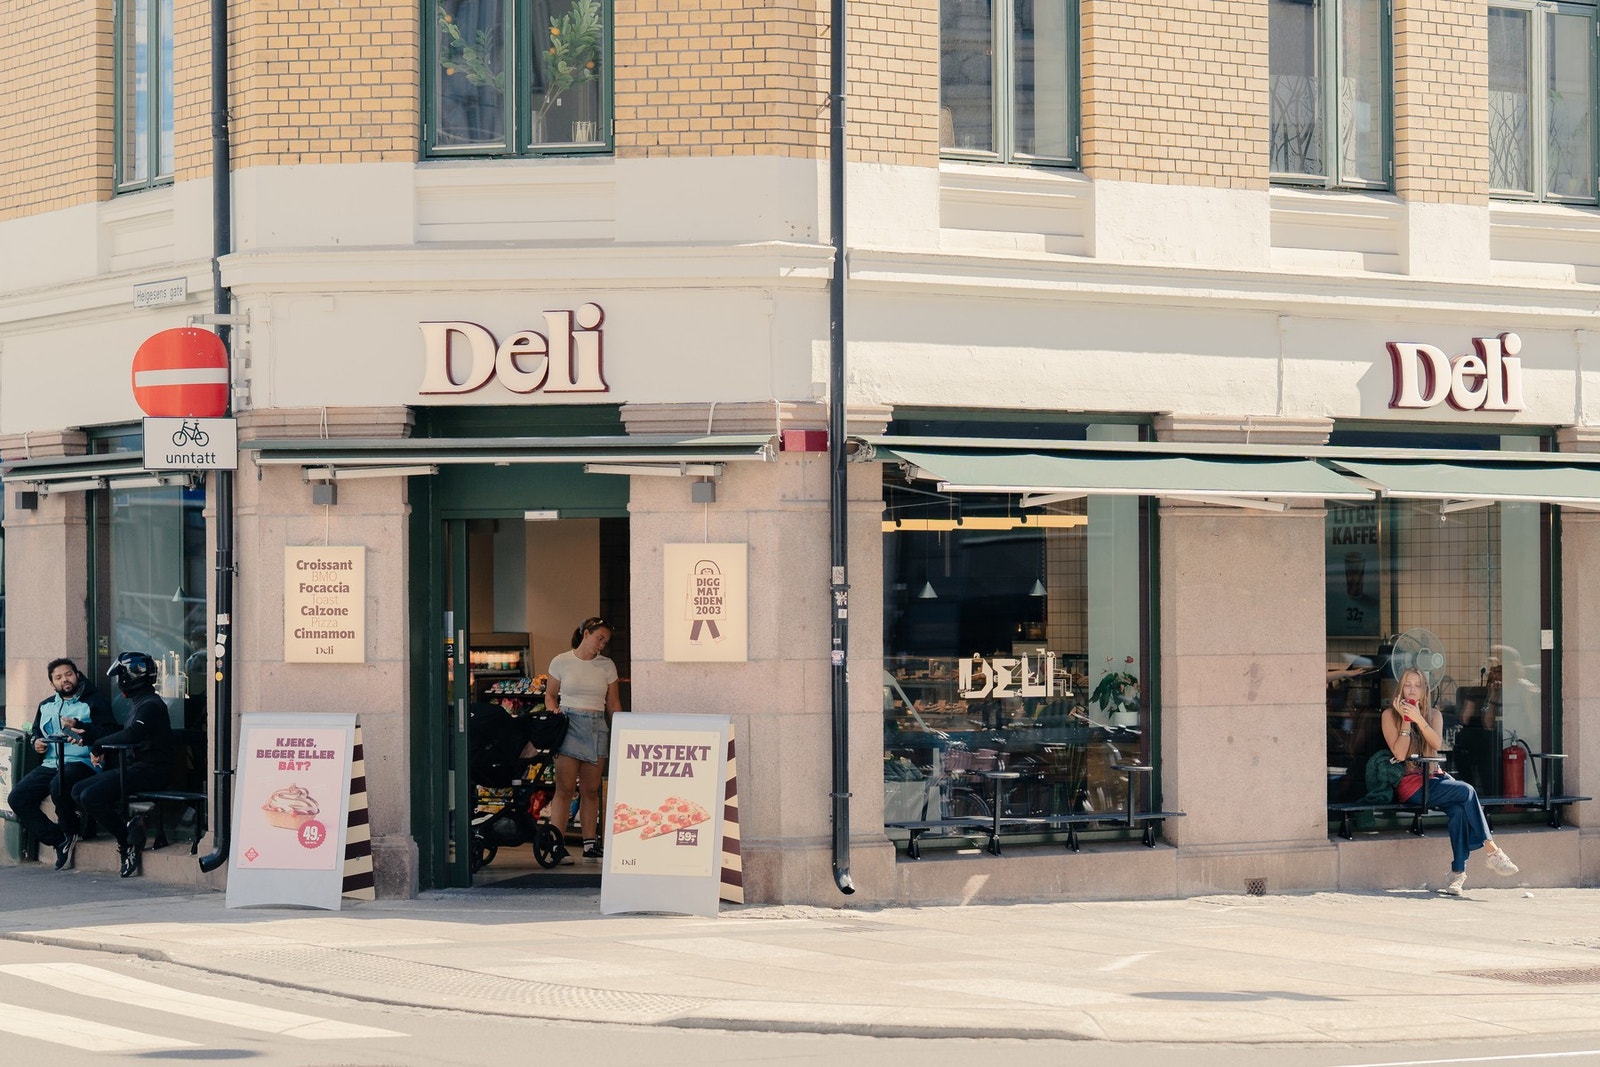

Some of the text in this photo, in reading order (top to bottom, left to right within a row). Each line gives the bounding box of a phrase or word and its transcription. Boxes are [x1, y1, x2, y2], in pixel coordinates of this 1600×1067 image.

[136, 286, 183, 304] Helgesens gate
[419, 302, 610, 395] Deli
[1386, 332, 1526, 412] Deli
[166, 452, 216, 464] unntatt
[1333, 505, 1375, 524] LITEN
[1332, 525, 1377, 545] KAFFE
[296, 559, 353, 570] Croissant
[311, 571, 338, 582] BMO
[299, 582, 350, 593] Focaccia
[696, 578, 720, 587] DIGG
[697, 587, 720, 596] MAT
[311, 594, 339, 605] Toast
[693, 596, 723, 606] SIDEN
[300, 605, 349, 616] Calzone
[696, 606, 721, 615] 2003
[311, 617, 338, 628] Pizza
[294, 628, 355, 639] Cinnamon
[315, 646, 334, 655] Deli
[276, 738, 317, 748] KJEKS,
[256, 749, 335, 760] BEGER ELLER
[626, 743, 712, 761] NYSTEKT
[640, 761, 694, 778] PIZZA
[621, 858, 637, 866] Deli
